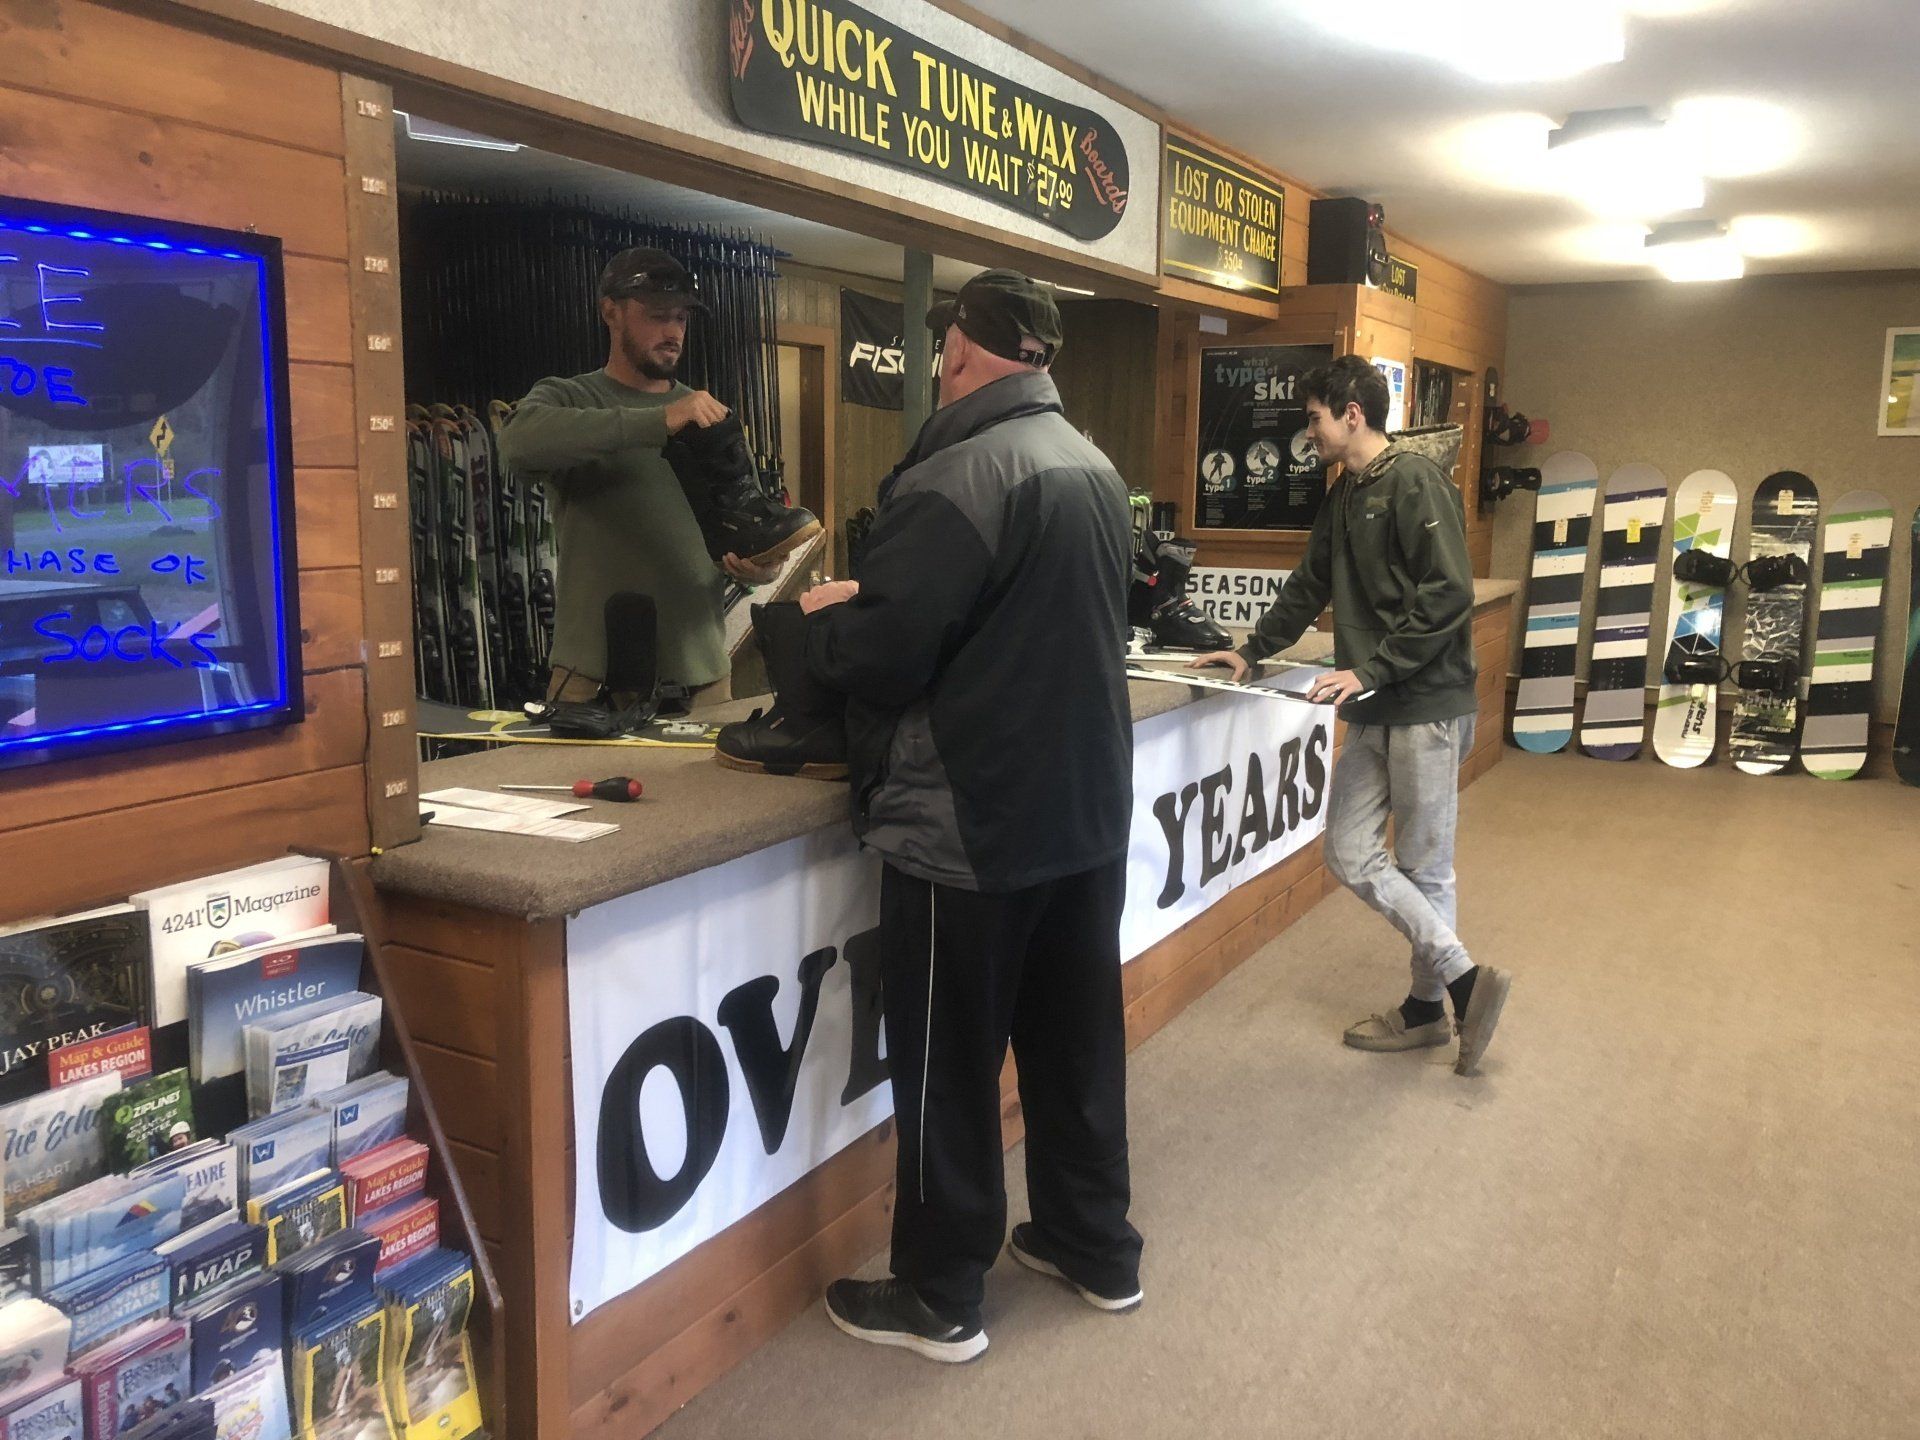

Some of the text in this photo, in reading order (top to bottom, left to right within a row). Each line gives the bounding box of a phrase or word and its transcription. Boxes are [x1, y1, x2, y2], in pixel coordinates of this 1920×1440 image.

[761, 0, 898, 97] QUICK
[913, 51, 998, 141] TUNE
[1001, 108, 1013, 139] &
[1014, 96, 1077, 174] WAX
[796, 71, 891, 150] WHILE
[902, 111, 950, 170] YOU
[963, 136, 1023, 196] WAIT
[1175, 160, 1277, 231] LOST OR STOLEN
[1169, 196, 1277, 262] EQUIPMENT CHARGE
[1214, 363, 1267, 388] type
[1254, 375, 1296, 401] ski
[1246, 469, 1274, 485] type 2
[1289, 457, 1317, 474] type 3
[1204, 482, 1225, 493] type
[1185, 573, 1283, 597] SEASON
[33, 612, 219, 669] SOCKS
[1153, 723, 1328, 910] YEARS
[234, 885, 321, 917] Magazine
[234, 981, 326, 1021] Whistler
[0, 1021, 108, 1076] JAY PEAK
[60, 1035, 145, 1069] Map & Guide
[60, 1062, 99, 1084] LAKES
[100, 1048, 146, 1073] REGION
[364, 1168, 425, 1205] LAKES REGION
[367, 1176, 388, 1191] Map
[379, 1237, 407, 1260] LAKES
[193, 1249, 253, 1292] MAP
